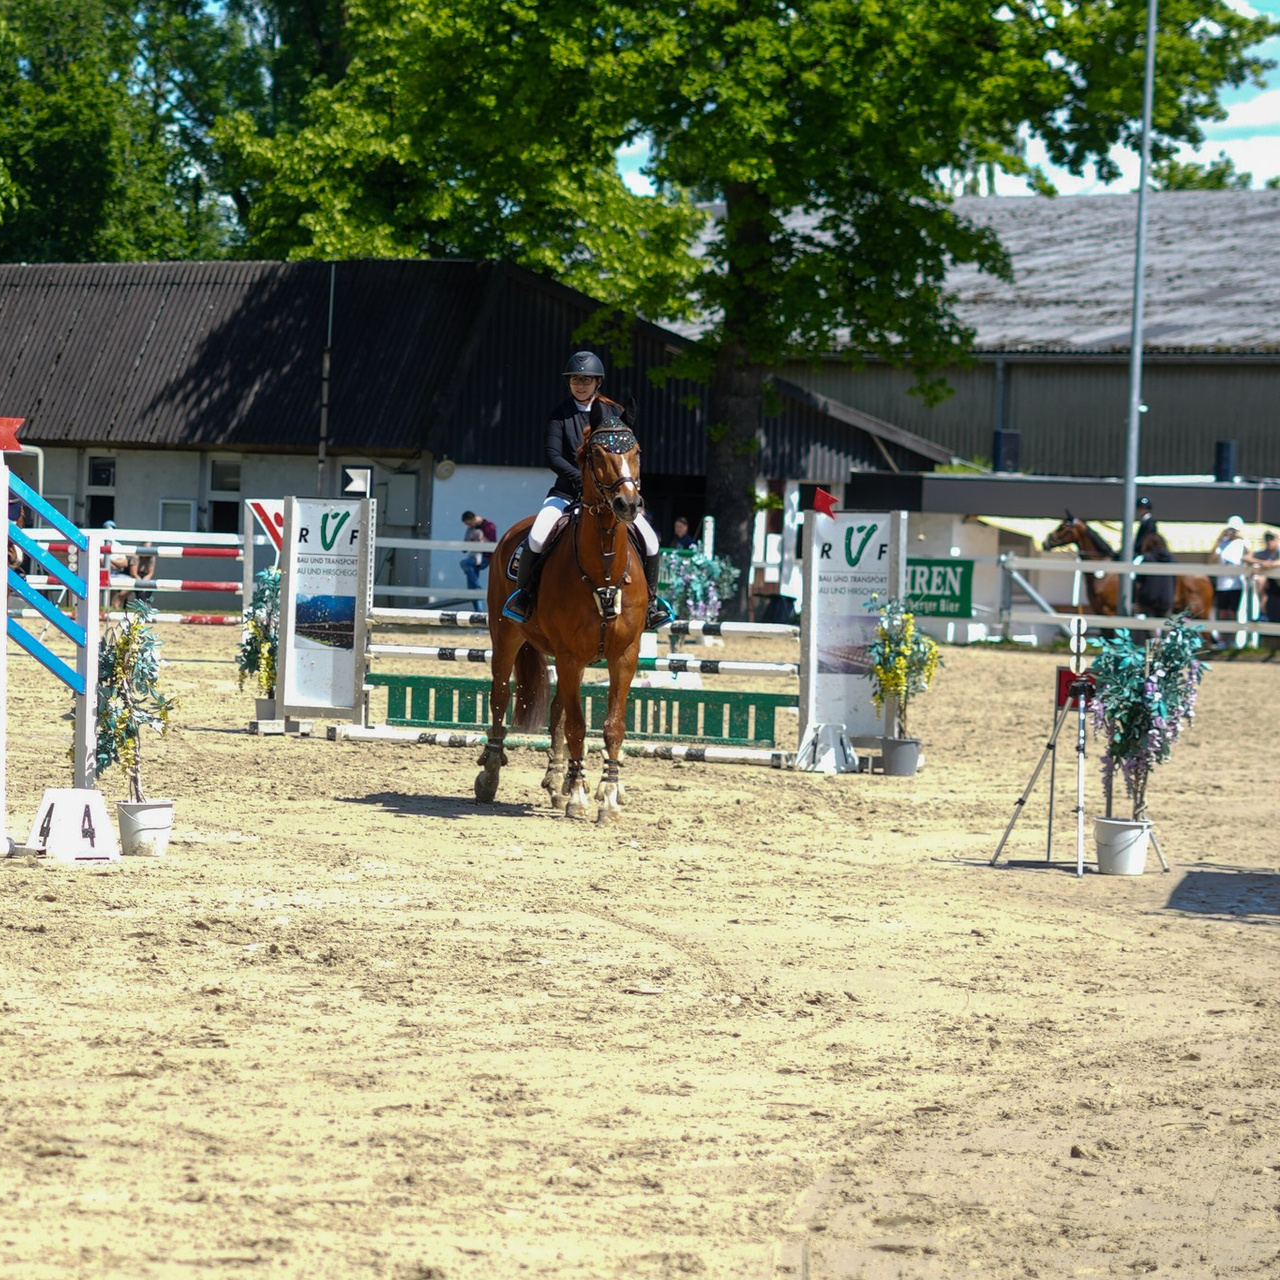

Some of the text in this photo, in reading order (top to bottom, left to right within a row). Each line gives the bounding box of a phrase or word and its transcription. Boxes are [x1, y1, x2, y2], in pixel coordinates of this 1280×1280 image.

[322, 568, 358, 577] HIRSCHEGG
[833, 575, 848, 583] UND
[850, 576, 887, 584] TRANSPORT
[831, 587, 846, 595] UND
[940, 599, 960, 613] Bier
[39, 802, 55, 847] 4
[81, 804, 96, 848] 4
